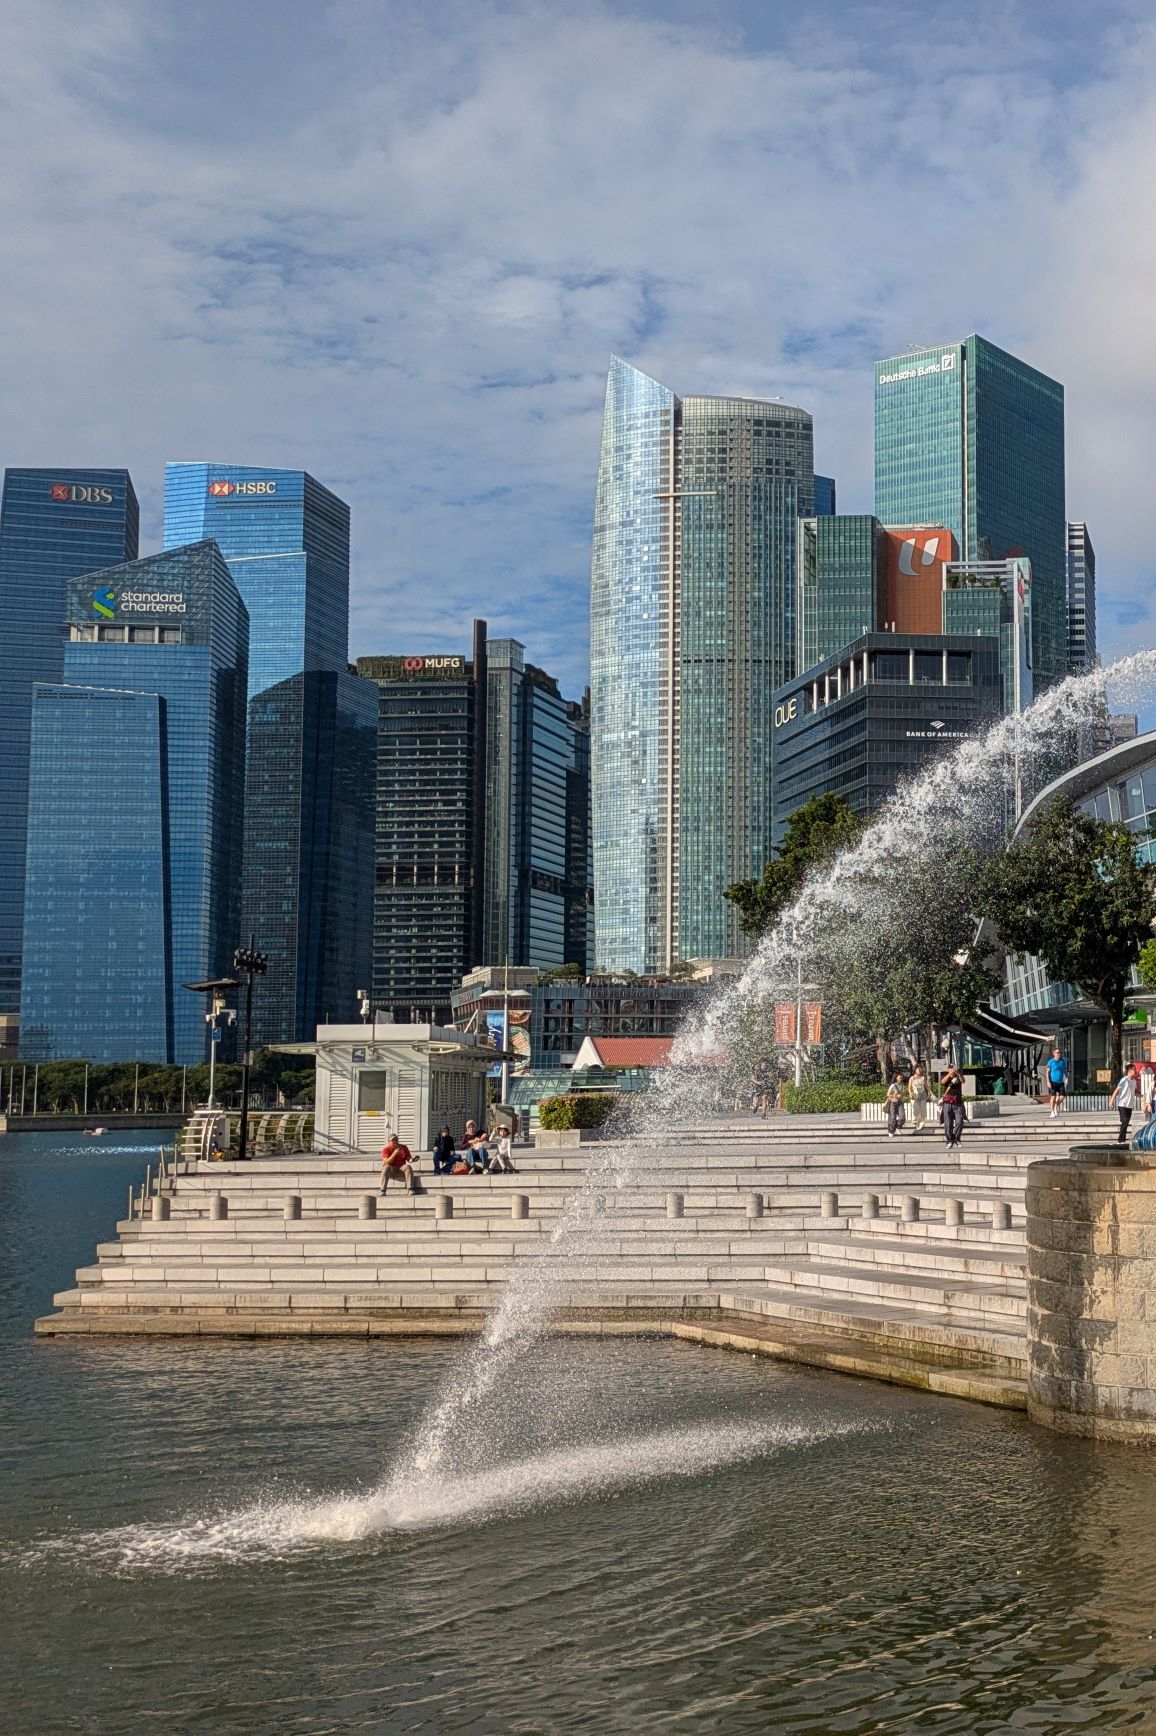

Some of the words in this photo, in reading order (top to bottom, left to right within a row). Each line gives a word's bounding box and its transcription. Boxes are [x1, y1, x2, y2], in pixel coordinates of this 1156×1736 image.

[879, 369, 916, 385] Deutsche
[917, 364, 940, 377] Bank
[236, 482, 276, 494] HSBC
[71, 486, 112, 504] DBS
[121, 591, 183, 603] standard
[121, 601, 186, 613] chartered
[425, 658, 460, 668] MUFG
[775, 698, 798, 727] OUE
